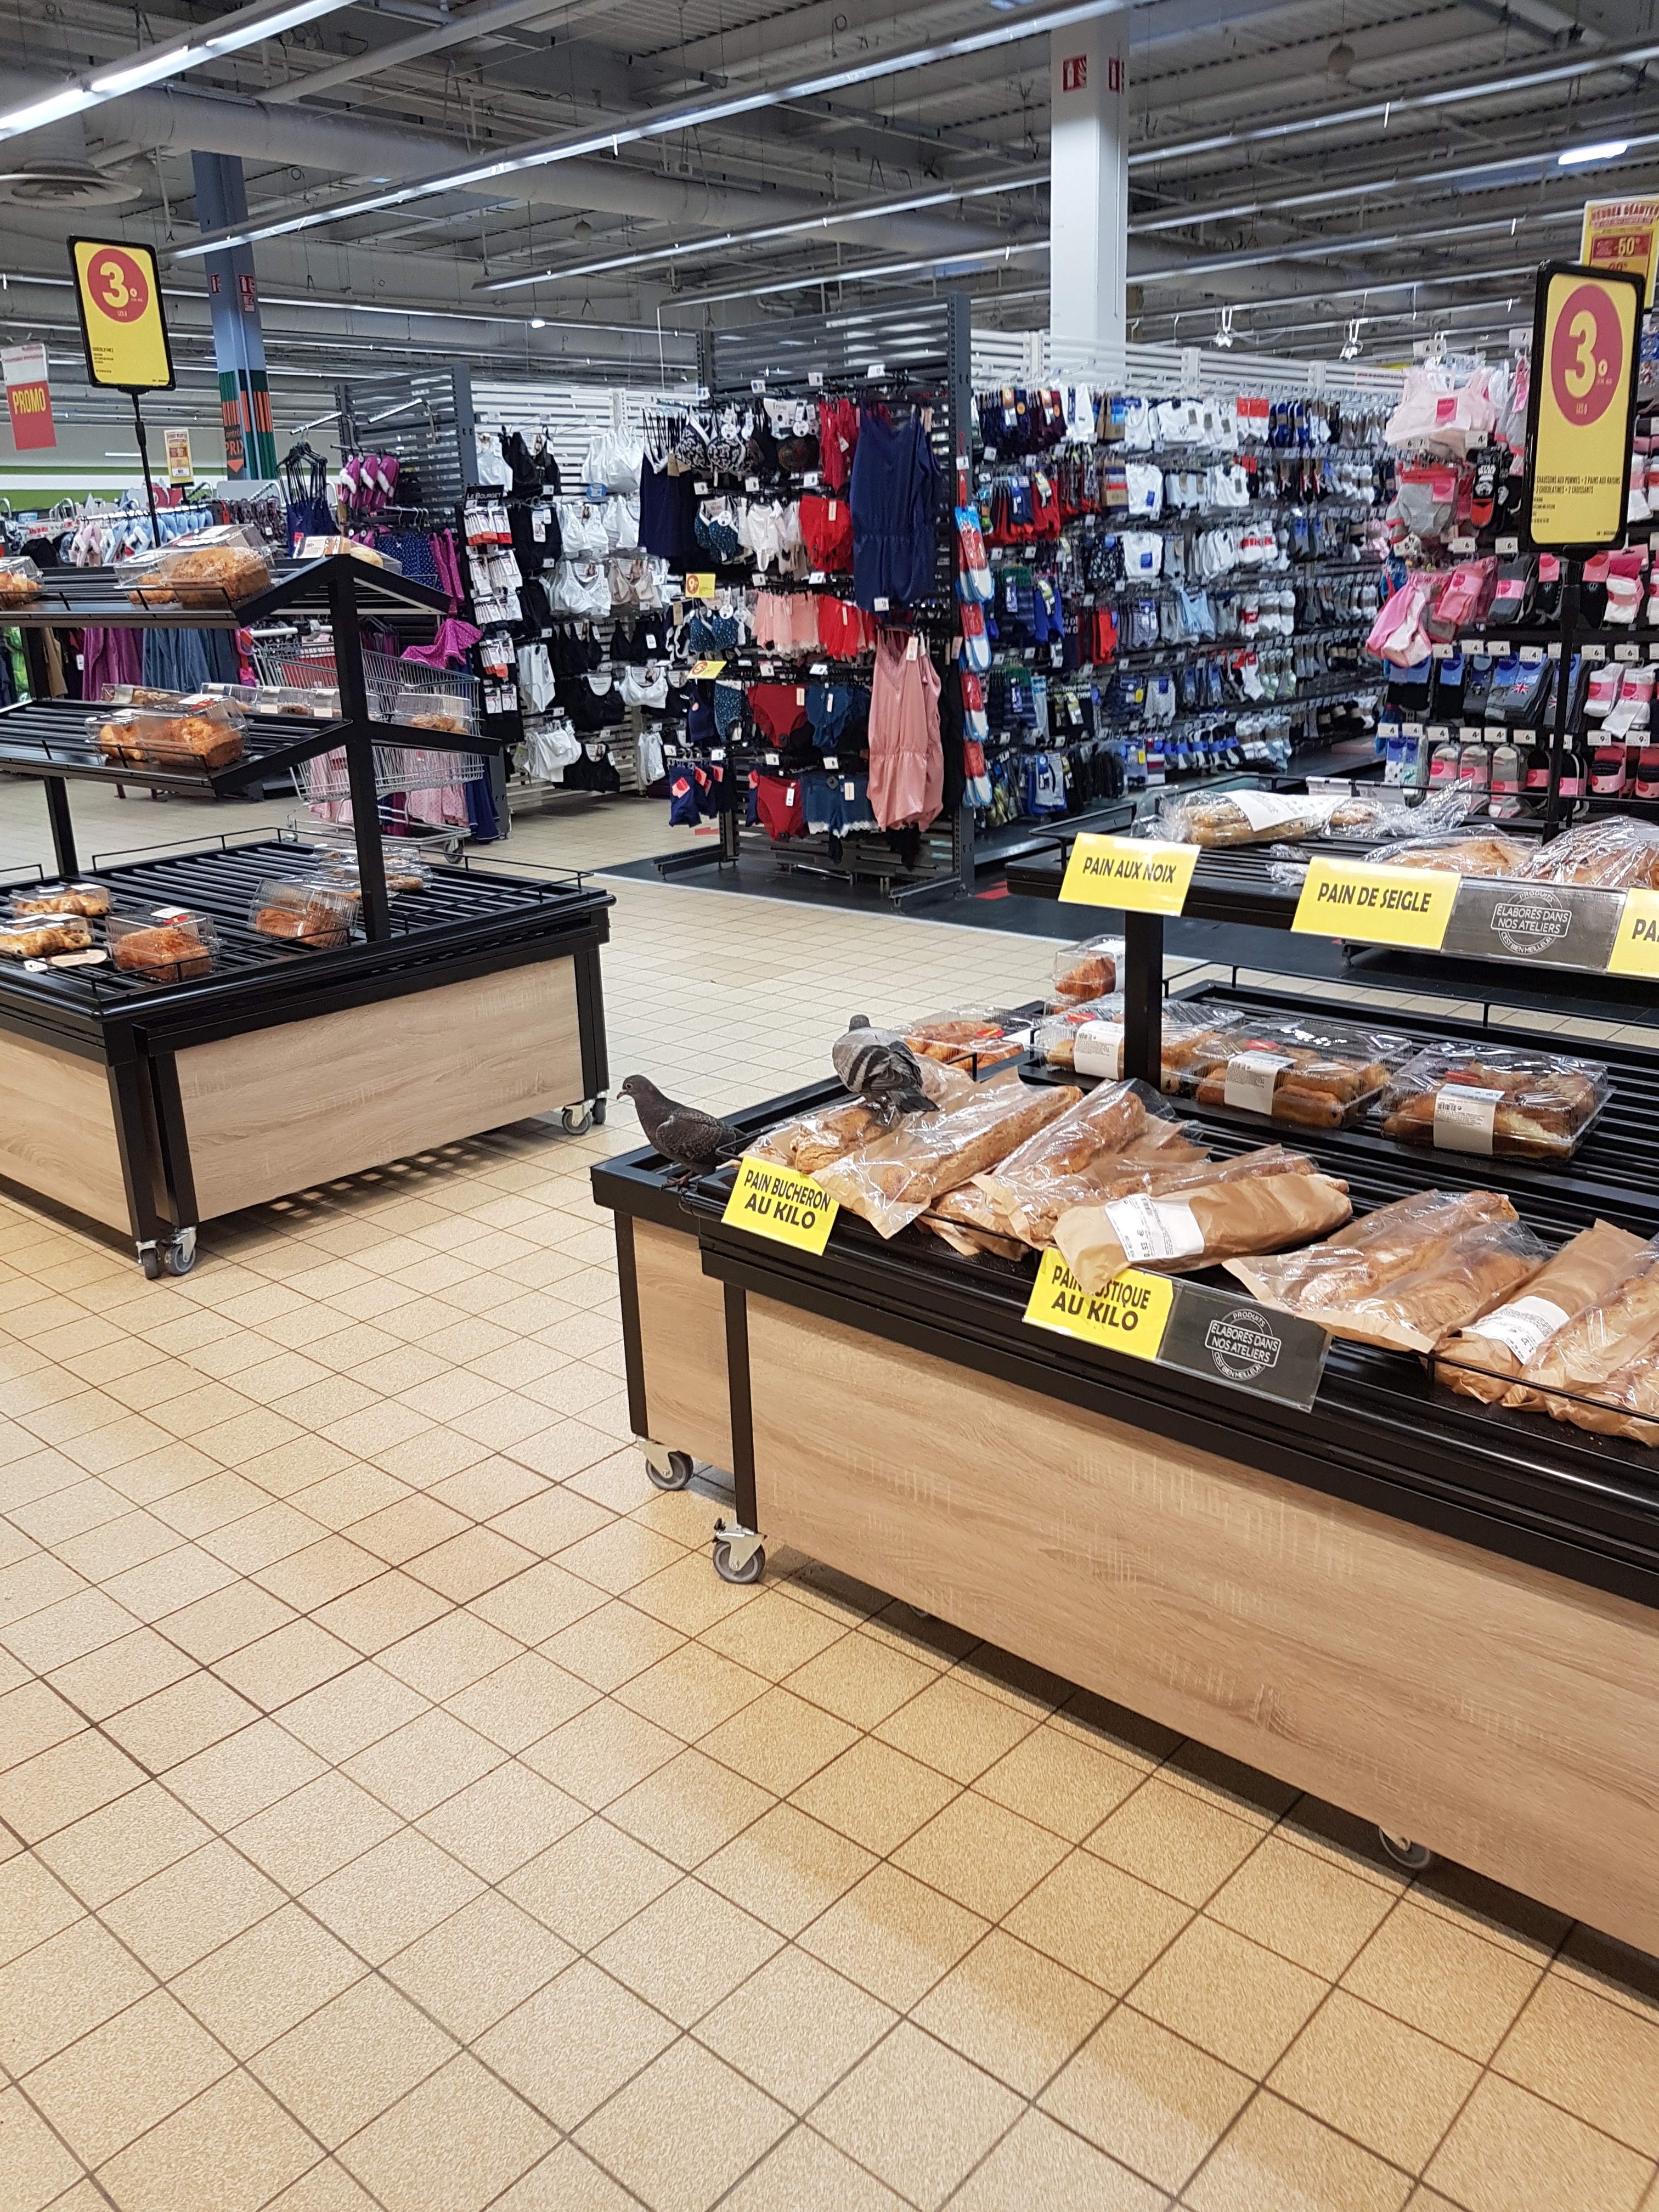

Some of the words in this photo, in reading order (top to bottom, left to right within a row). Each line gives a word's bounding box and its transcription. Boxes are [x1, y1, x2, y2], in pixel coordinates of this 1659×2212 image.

[100, 261, 129, 308] 3
[1565, 309, 1598, 399] 3
[12, 387, 46, 415] PROMO
[1082, 857, 1115, 877] PAIN
[1114, 860, 1143, 880] AUX
[1142, 862, 1177, 883] NOIX
[1317, 882, 1357, 905] PAIN
[1357, 886, 1380, 907] DE
[1380, 888, 1432, 913] SEIGLE
[1519, 890, 1554, 902] PRODUITS
[1496, 905, 1543, 920] ÉLABORÉS
[1543, 911, 1569, 923] DANS
[1498, 917, 1519, 929] NOS
[1518, 919, 1561, 934] ATELIERS
[1510, 943, 1524, 953] BIEN
[1524, 936, 1553, 953] MEILLEUR
[1632, 918, 1659, 943] PA
[744, 1169, 772, 1193] PAIN
[771, 1177, 831, 1212] BUCHERON
[744, 1193, 772, 1215] AU
[773, 1201, 816, 1229] KILO
[1092, 1279, 1152, 1310] STIQUE
[1051, 1291, 1084, 1315] AU
[1087, 1299, 1138, 1331] KILO
[1211, 1323, 1254, 1345] ÉLABORÉS
[1254, 1335, 1278, 1352] DANS
[1211, 1336, 1232, 1351] NOS
[1231, 1342, 1271, 1363] ATELIERS
